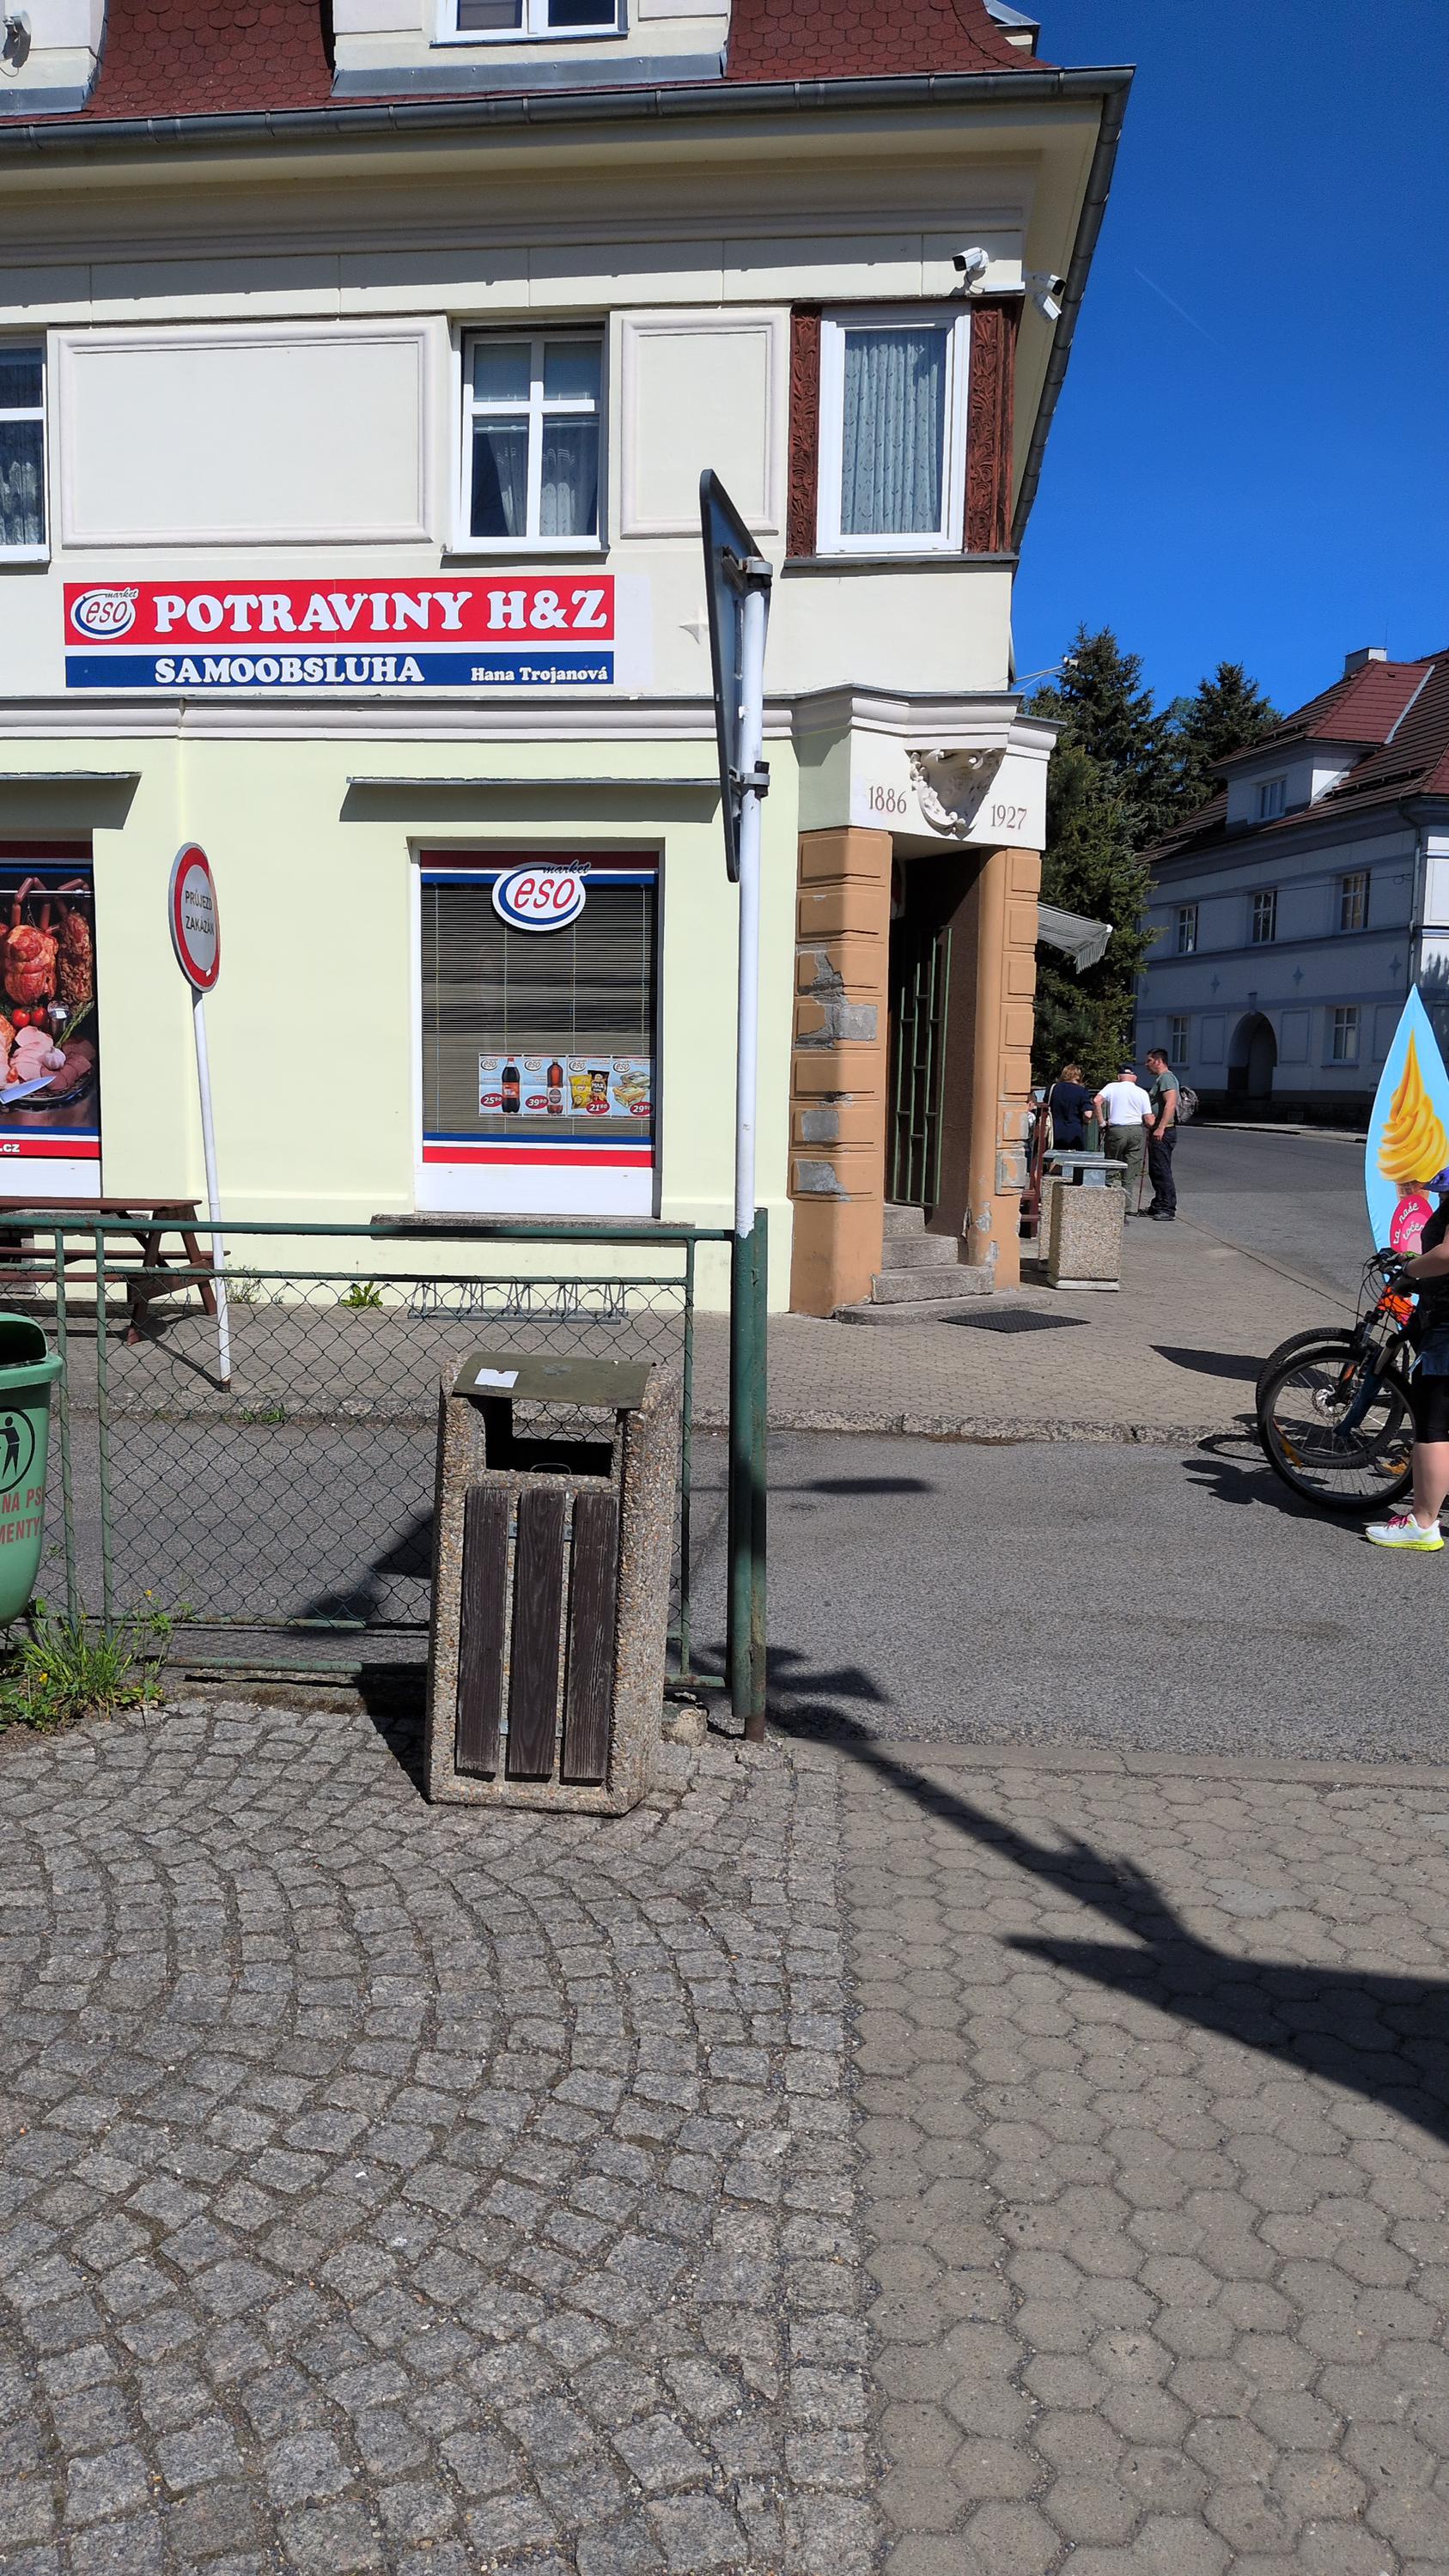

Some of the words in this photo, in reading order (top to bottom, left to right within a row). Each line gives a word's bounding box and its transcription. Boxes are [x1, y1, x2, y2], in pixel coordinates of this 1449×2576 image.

[105, 588, 137, 598] market
[86, 601, 127, 623] eso
[152, 592, 473, 633] POTRAVINY
[486, 589, 608, 629] H&Z
[155, 656, 425, 683] SAMOOBSLUHA
[471, 667, 515, 681] Hana
[519, 666, 608, 683] Trojanová
[868, 785, 907, 814] 1886
[990, 804, 1027, 830] 1927
[542, 860, 591, 874] market
[185, 888, 213, 910] PRŮJEZD
[514, 878, 575, 909] eso
[185, 915, 215, 936] ZAKÁZÁN
